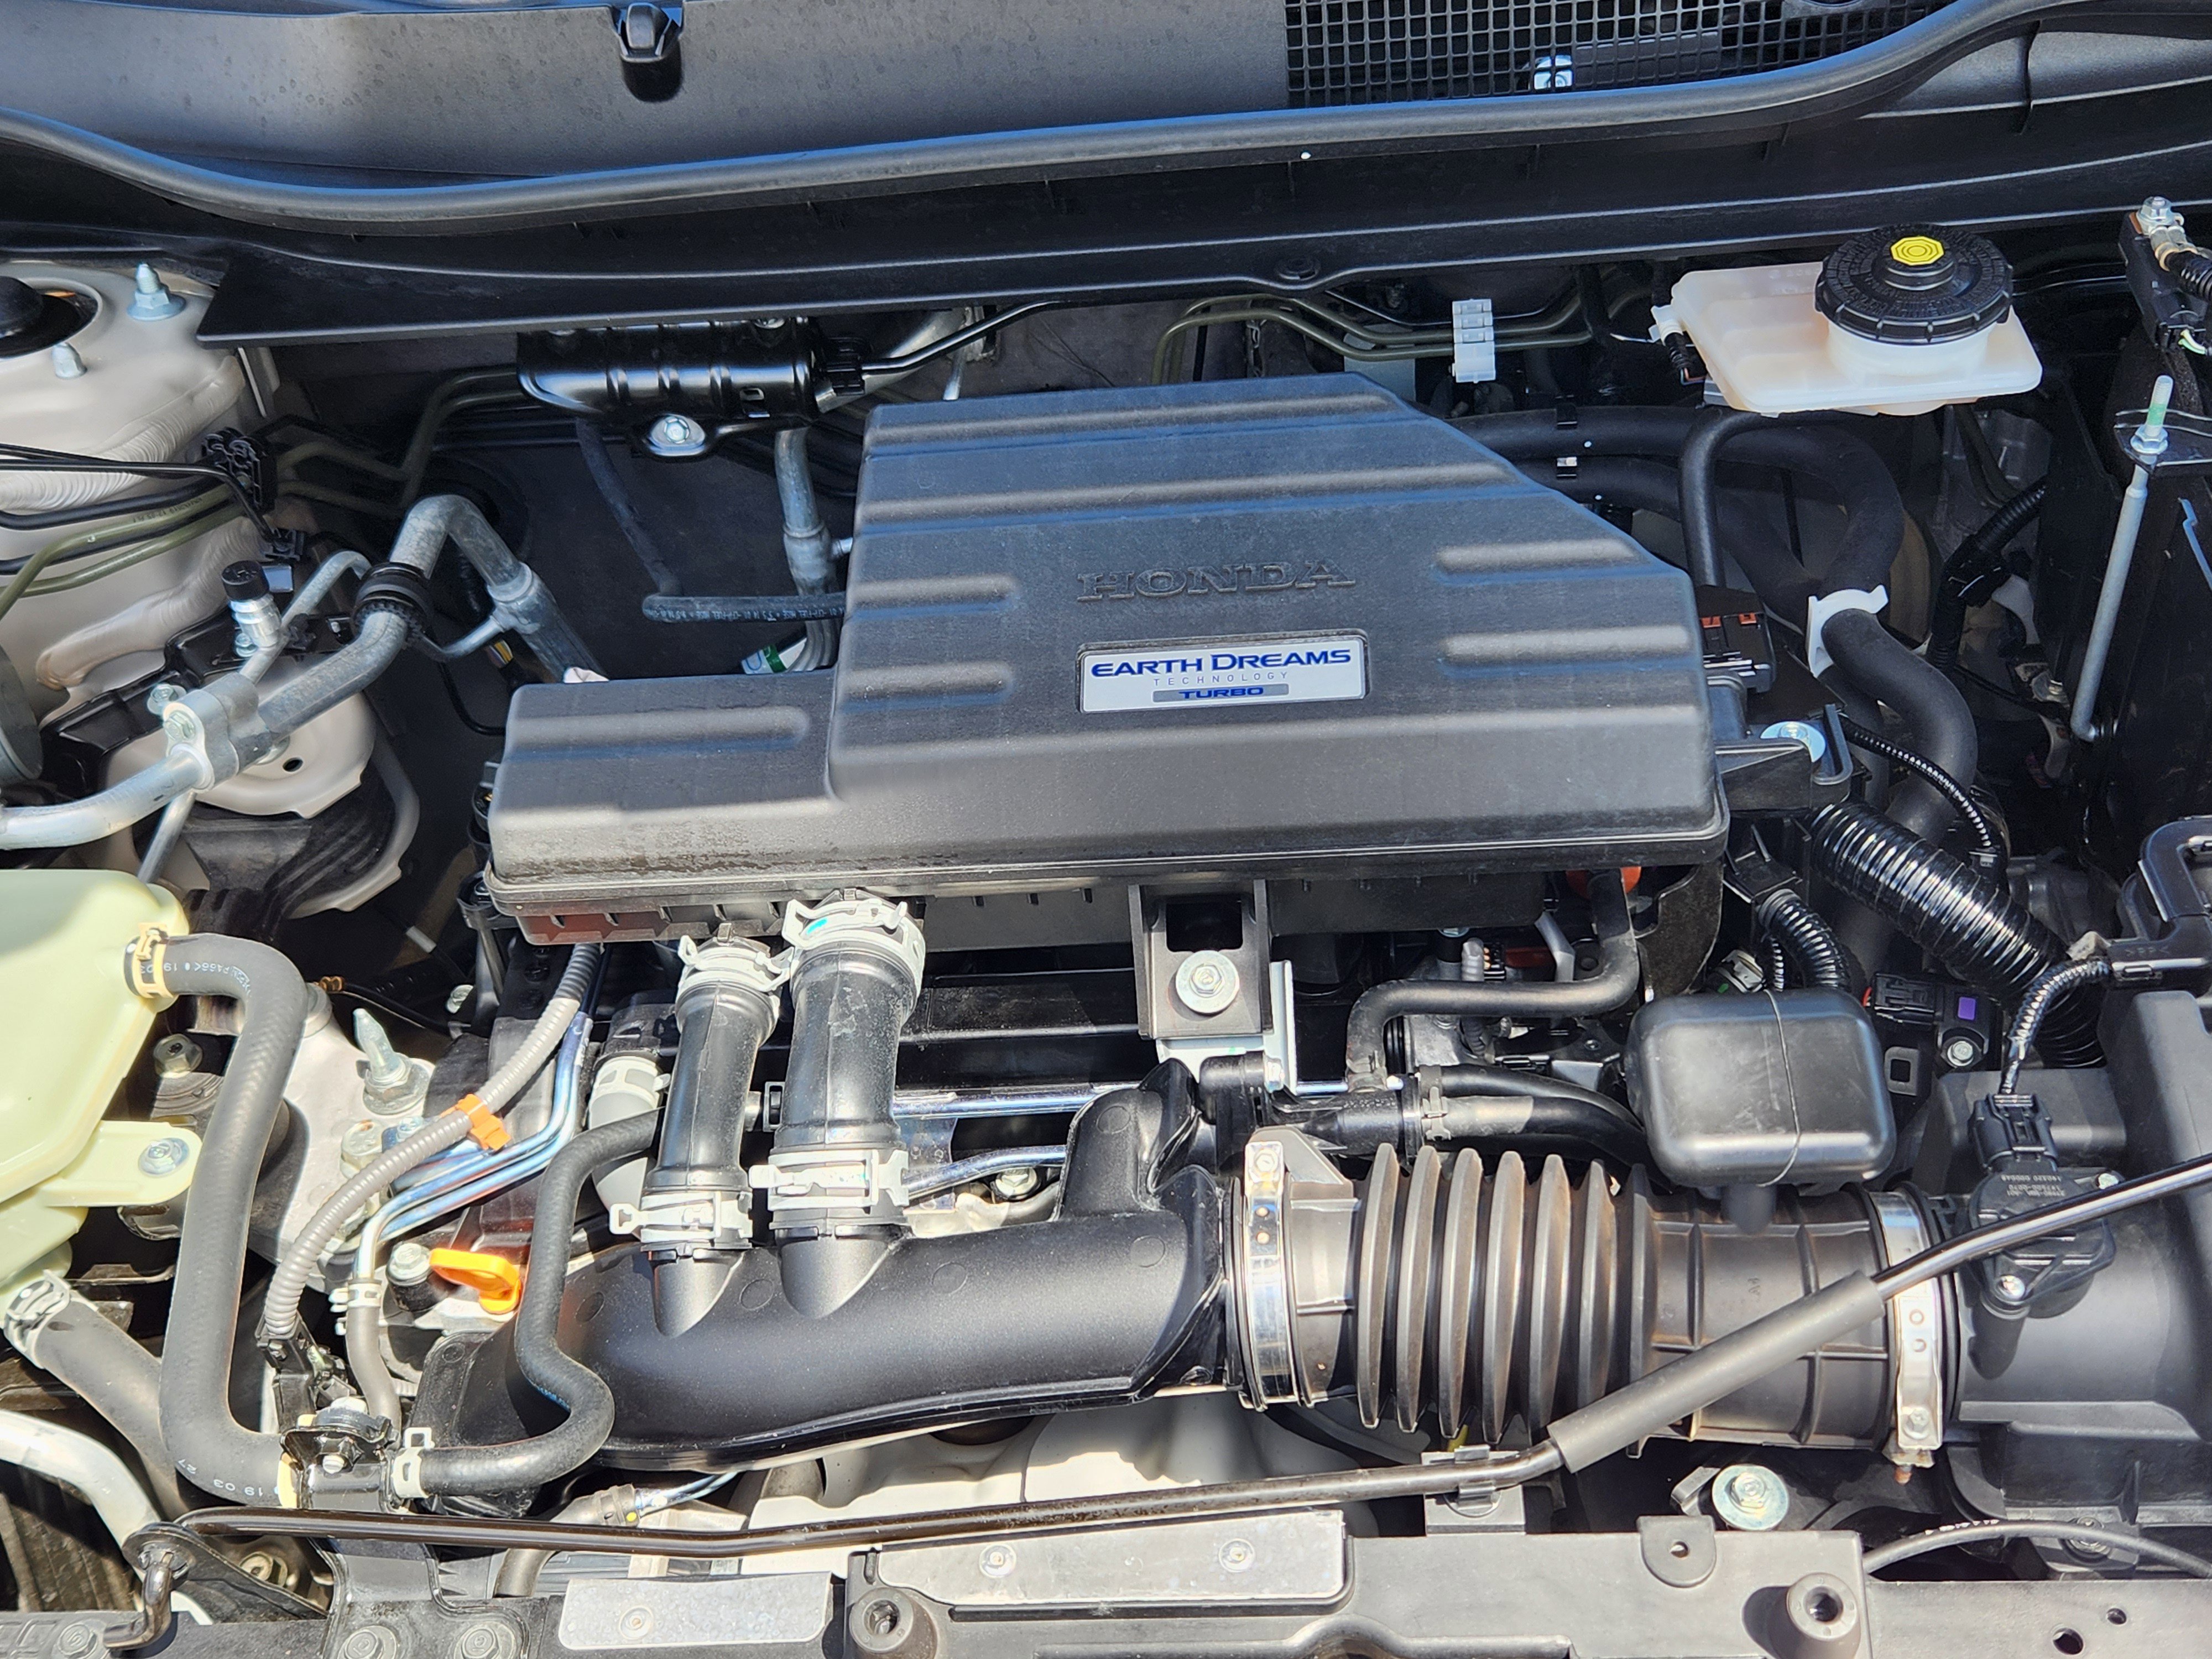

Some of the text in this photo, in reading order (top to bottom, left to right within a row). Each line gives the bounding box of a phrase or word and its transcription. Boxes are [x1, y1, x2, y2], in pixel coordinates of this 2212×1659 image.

[1077, 559, 1356, 602] HONDA
[1091, 649, 1351, 677] EARTH DREAMS
[1154, 671, 1288, 686] TECHNOLOGY
[1178, 686, 1264, 699] TURBO
[213, 1479, 236, 1491] 03
[244, 1486, 263, 1496] 19
